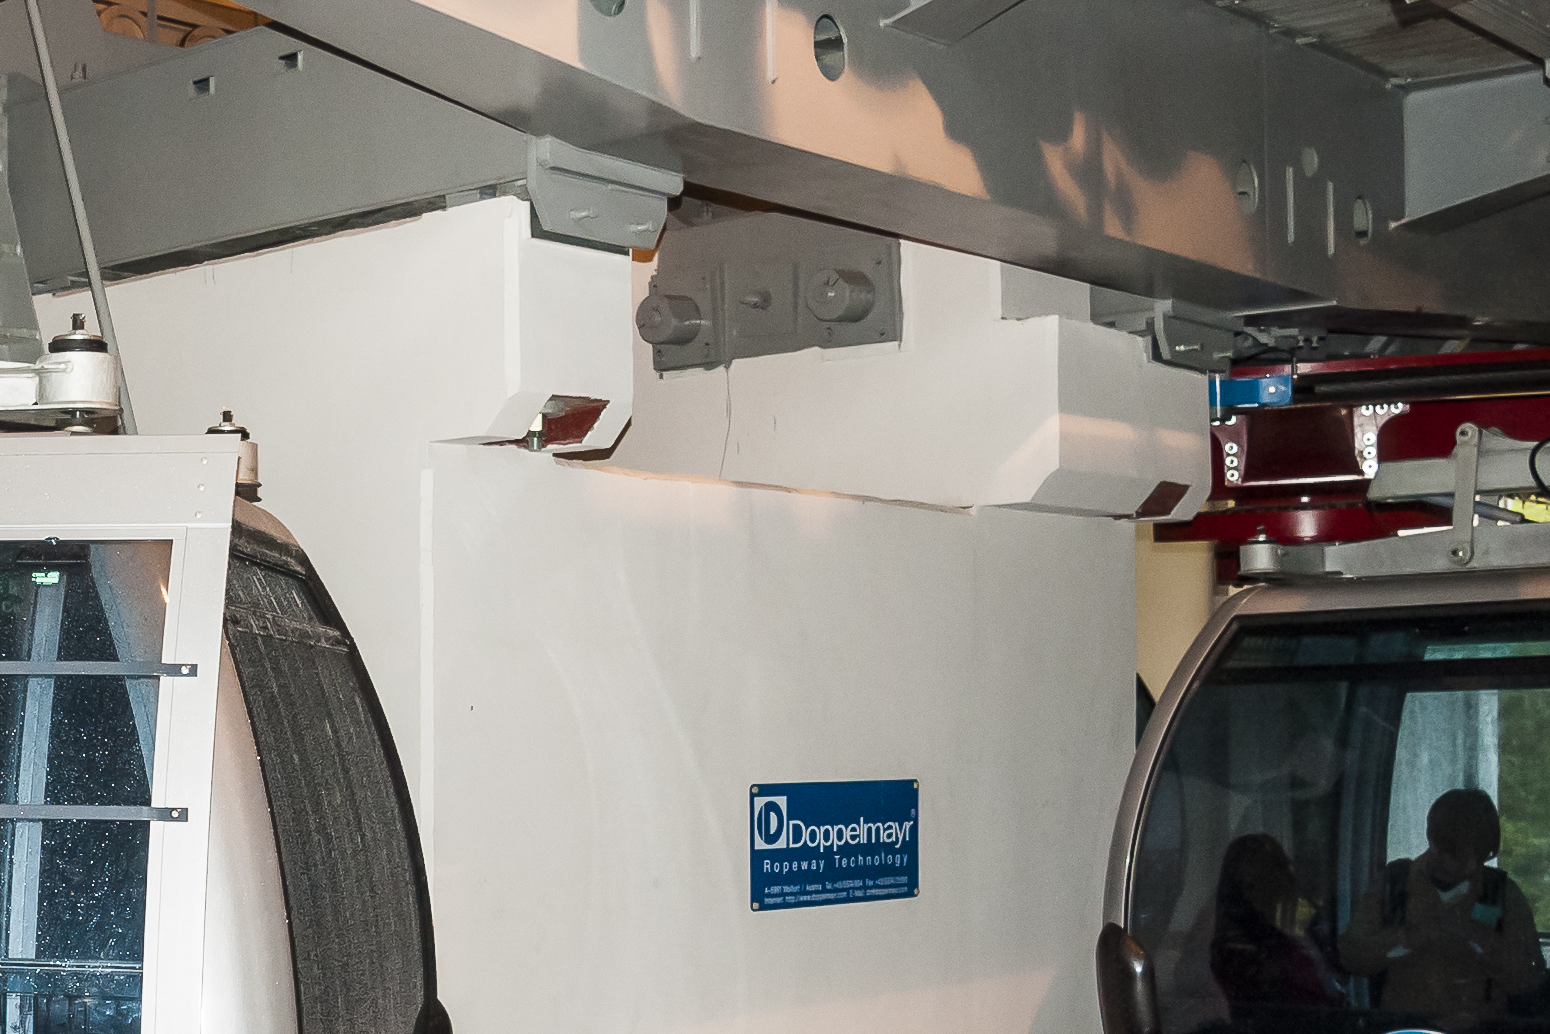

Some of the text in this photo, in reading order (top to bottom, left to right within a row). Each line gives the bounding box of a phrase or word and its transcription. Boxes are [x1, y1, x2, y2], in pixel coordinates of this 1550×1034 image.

[788, 816, 914, 853] Doppelmayr
[763, 851, 908, 875] Ropeway Technology
